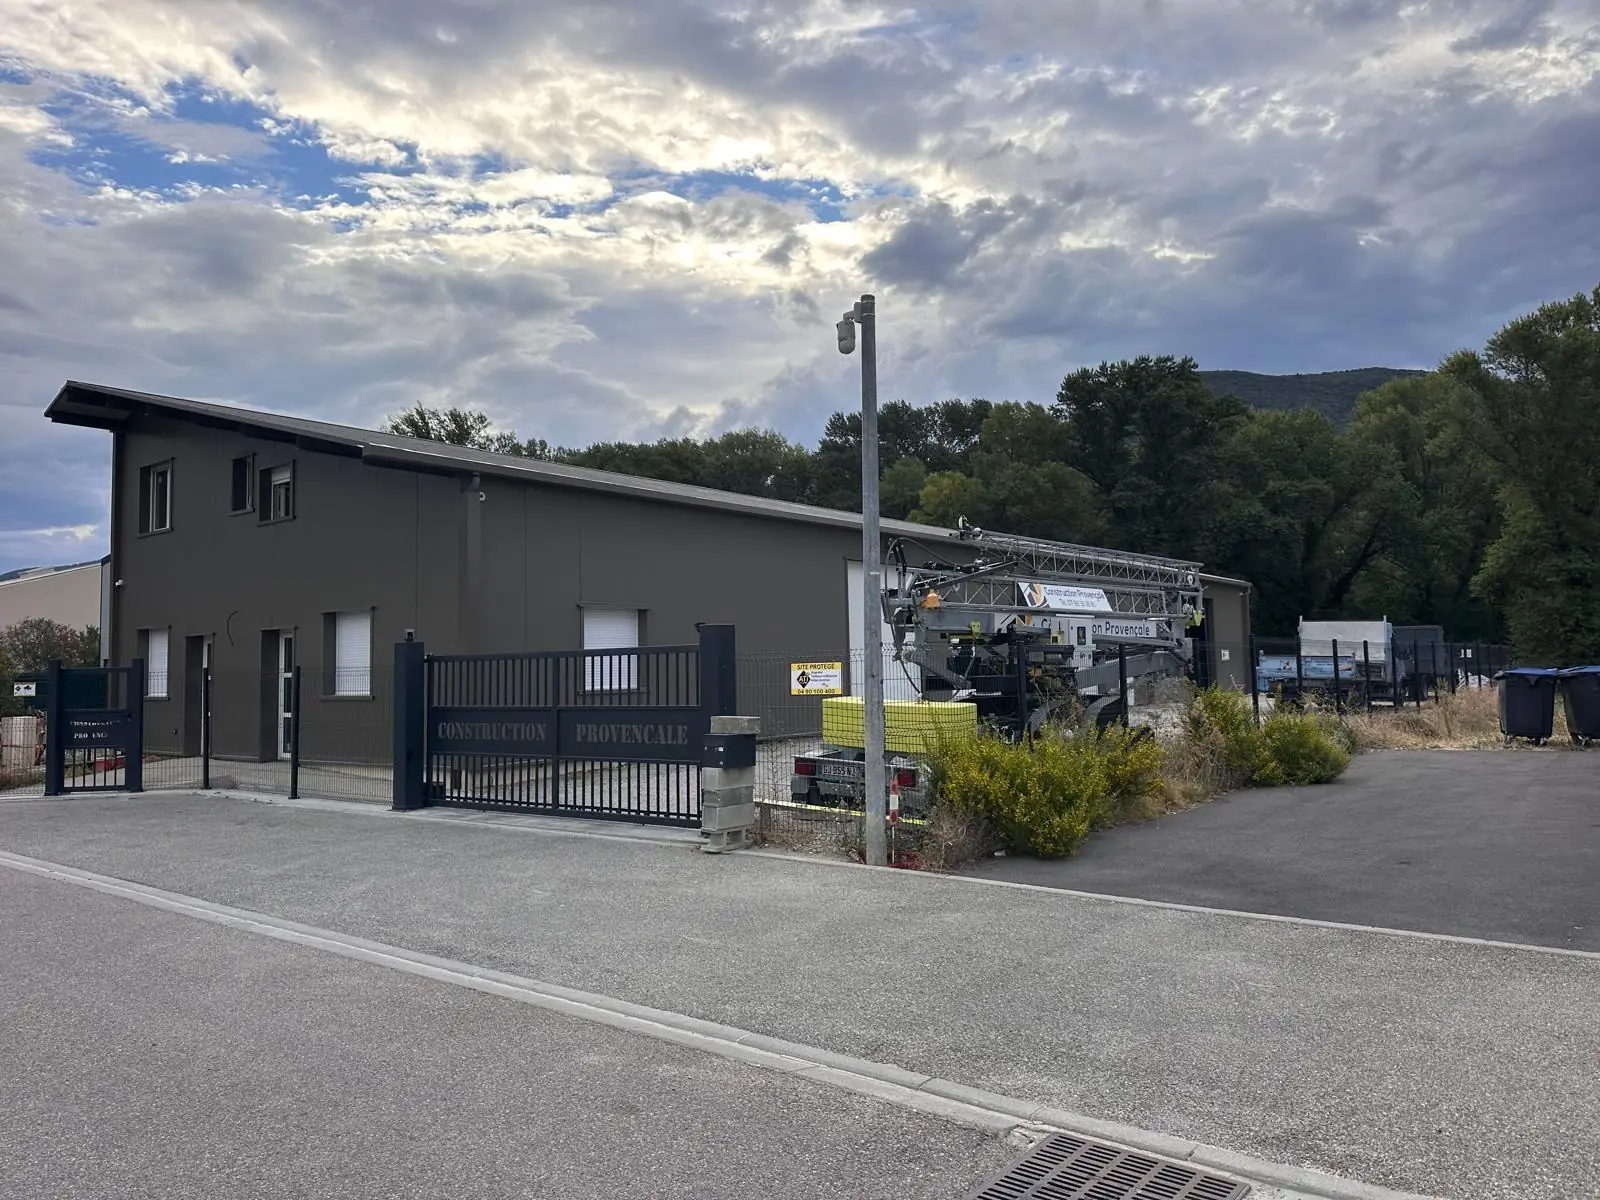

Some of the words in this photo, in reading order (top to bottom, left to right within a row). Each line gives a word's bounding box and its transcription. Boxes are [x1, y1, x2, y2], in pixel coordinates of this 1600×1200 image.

[1044, 586, 1077, 597] Construction
[1105, 621, 1150, 637] Provençale
[437, 721, 547, 741] CONSTRUCTION
[575, 723, 688, 745] PROVENCALE
